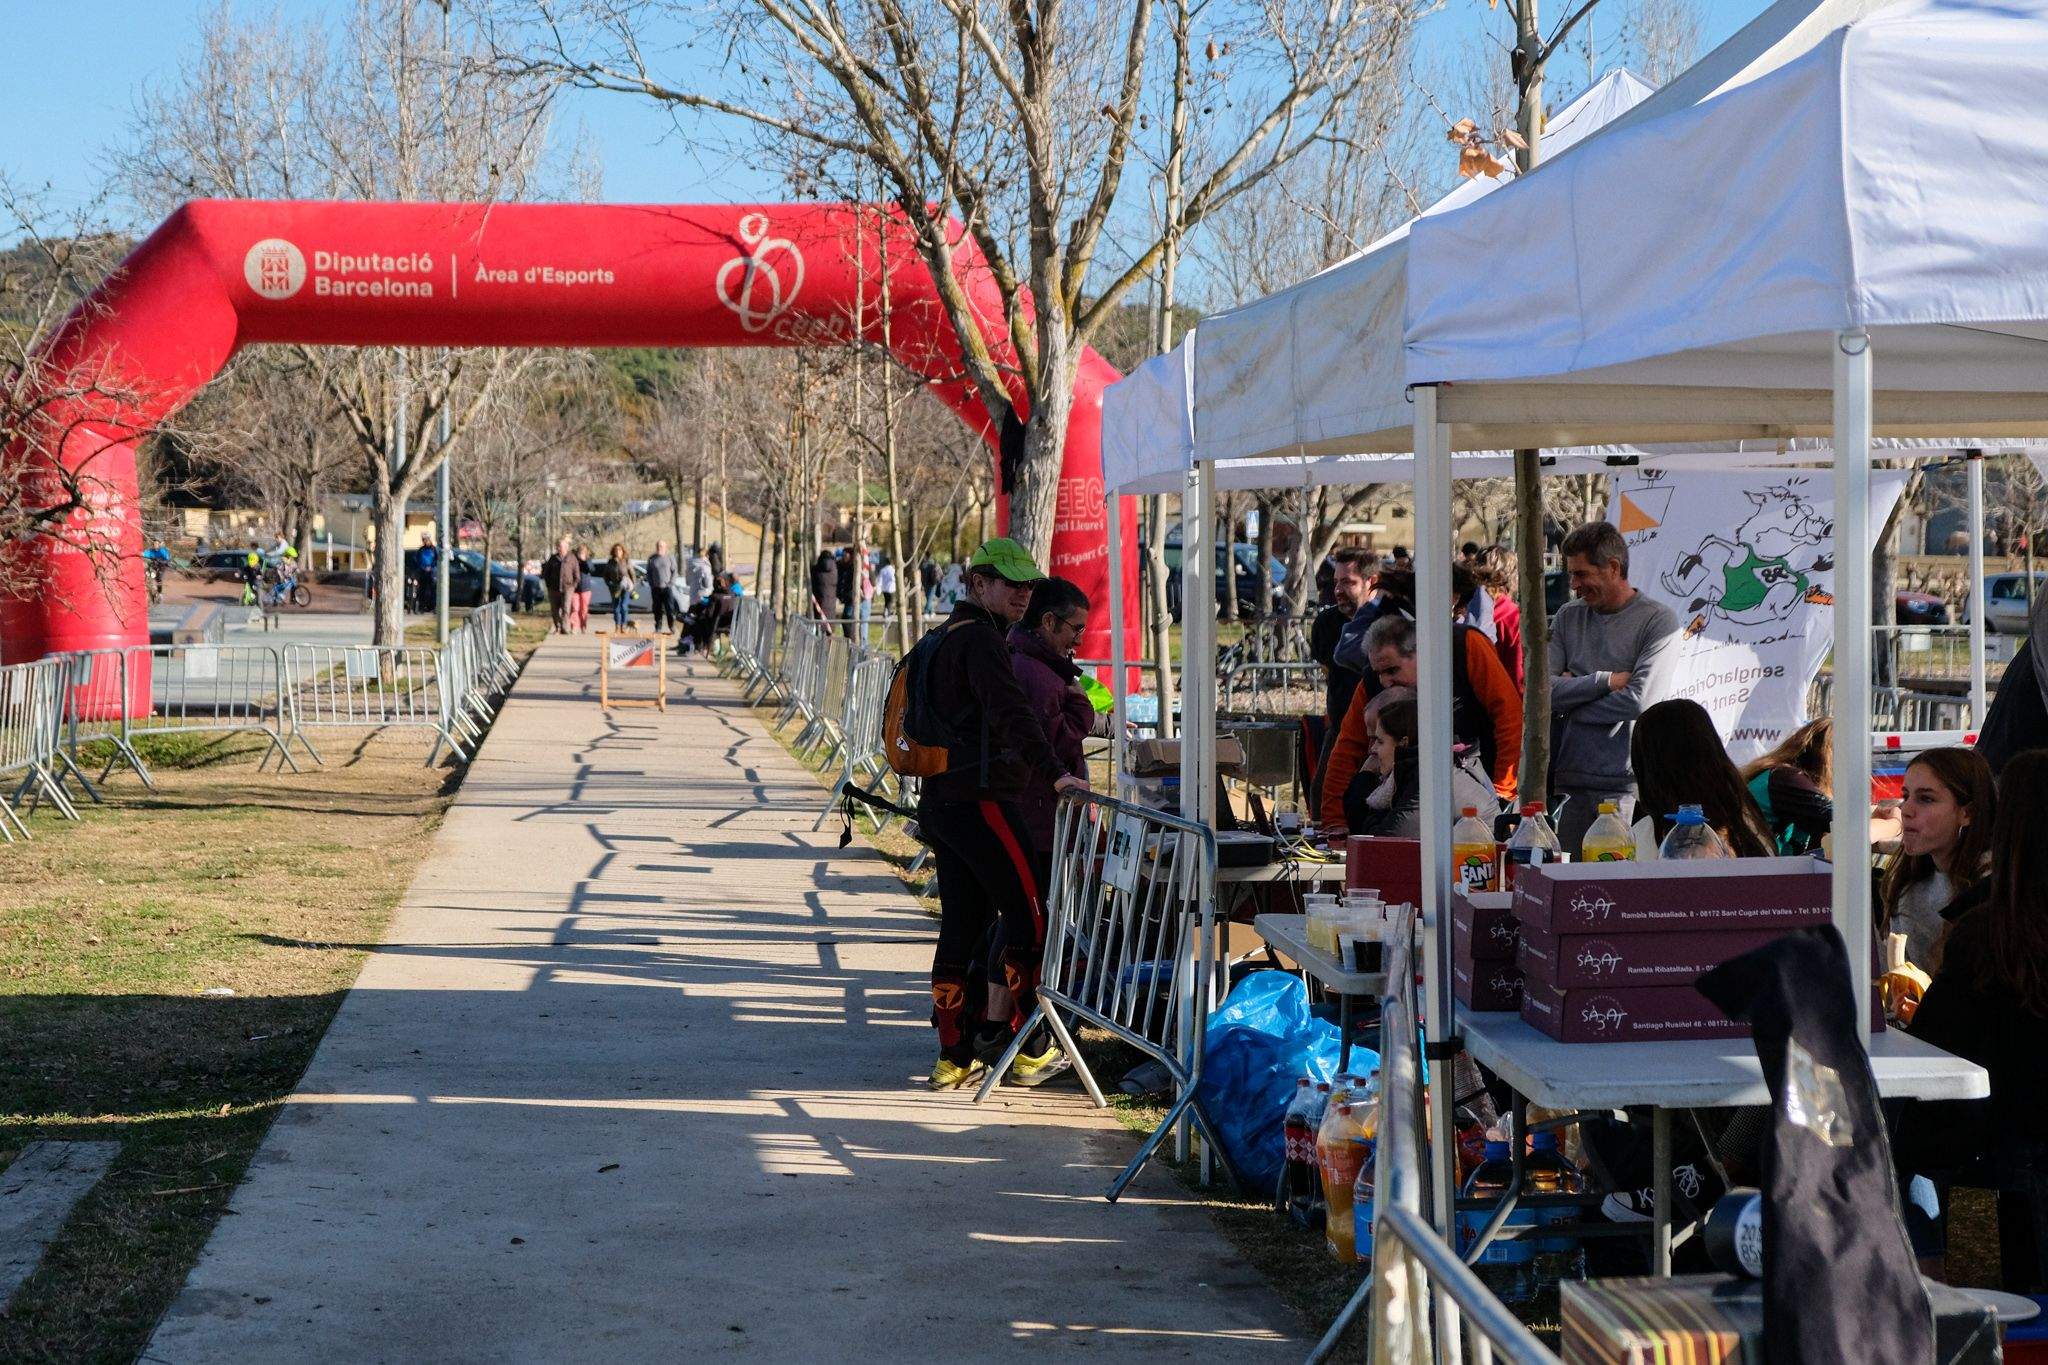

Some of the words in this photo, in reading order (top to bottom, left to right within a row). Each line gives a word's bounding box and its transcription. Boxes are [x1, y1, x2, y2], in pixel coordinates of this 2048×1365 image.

[314, 251, 433, 275] Diputació
[475, 261, 518, 283] Àrea
[524, 266, 615, 287] d'Esports
[314, 276, 432, 297] Barcelona
[1738, 910, 1758, 918] Cugat
[1627, 966, 1653, 974] Rambla
[1633, 1021, 1664, 1030] Santiago
